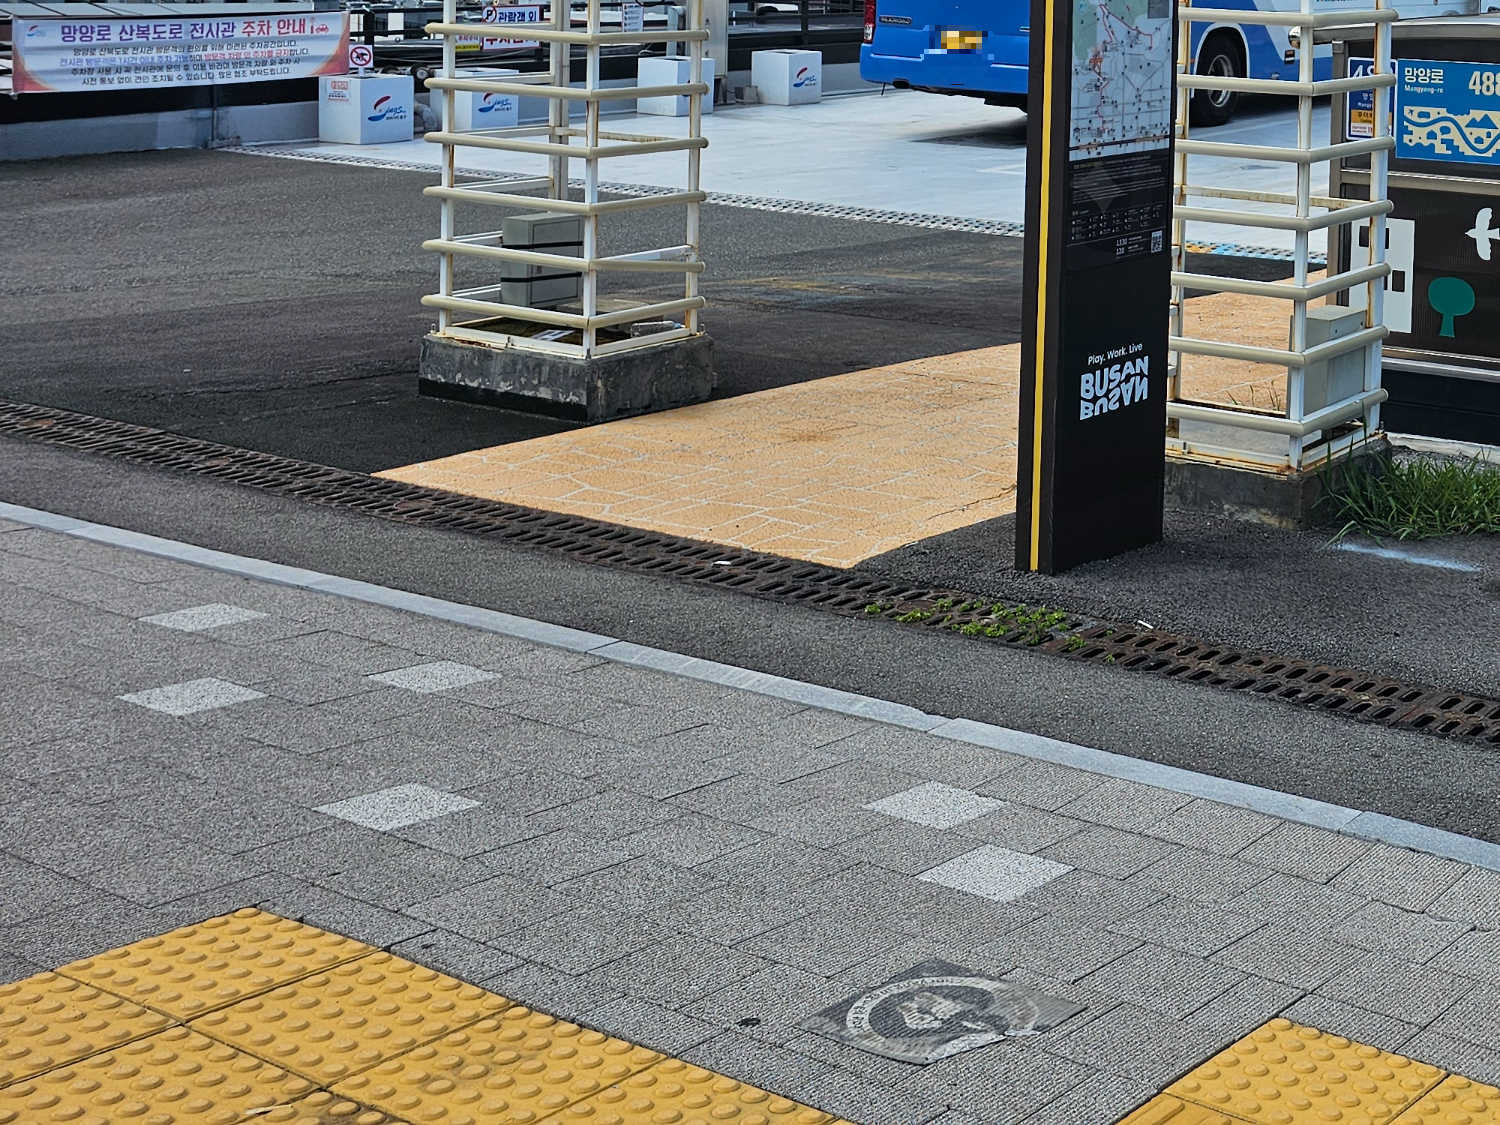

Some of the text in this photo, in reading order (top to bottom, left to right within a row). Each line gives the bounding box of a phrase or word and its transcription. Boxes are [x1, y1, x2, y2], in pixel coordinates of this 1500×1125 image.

[61, 25, 111, 42] 망양로
[119, 24, 183, 41] 산복도로
[190, 22, 236, 39] 전시관
[242, 19, 271, 37] 주차
[277, 18, 306, 35] 안내
[73, 47, 96, 56] 망양로
[132, 46, 153, 55] 전시관
[60, 58, 83, 67] 전시관
[157, 55, 172, 63] 주차
[1404, 67, 1444, 84] 망양로
[1404, 84, 1444, 94] Mangyang-ro
[1088, 343, 1143, 365] Play. Work. Live
[1081, 356, 1148, 400] BUSAN
